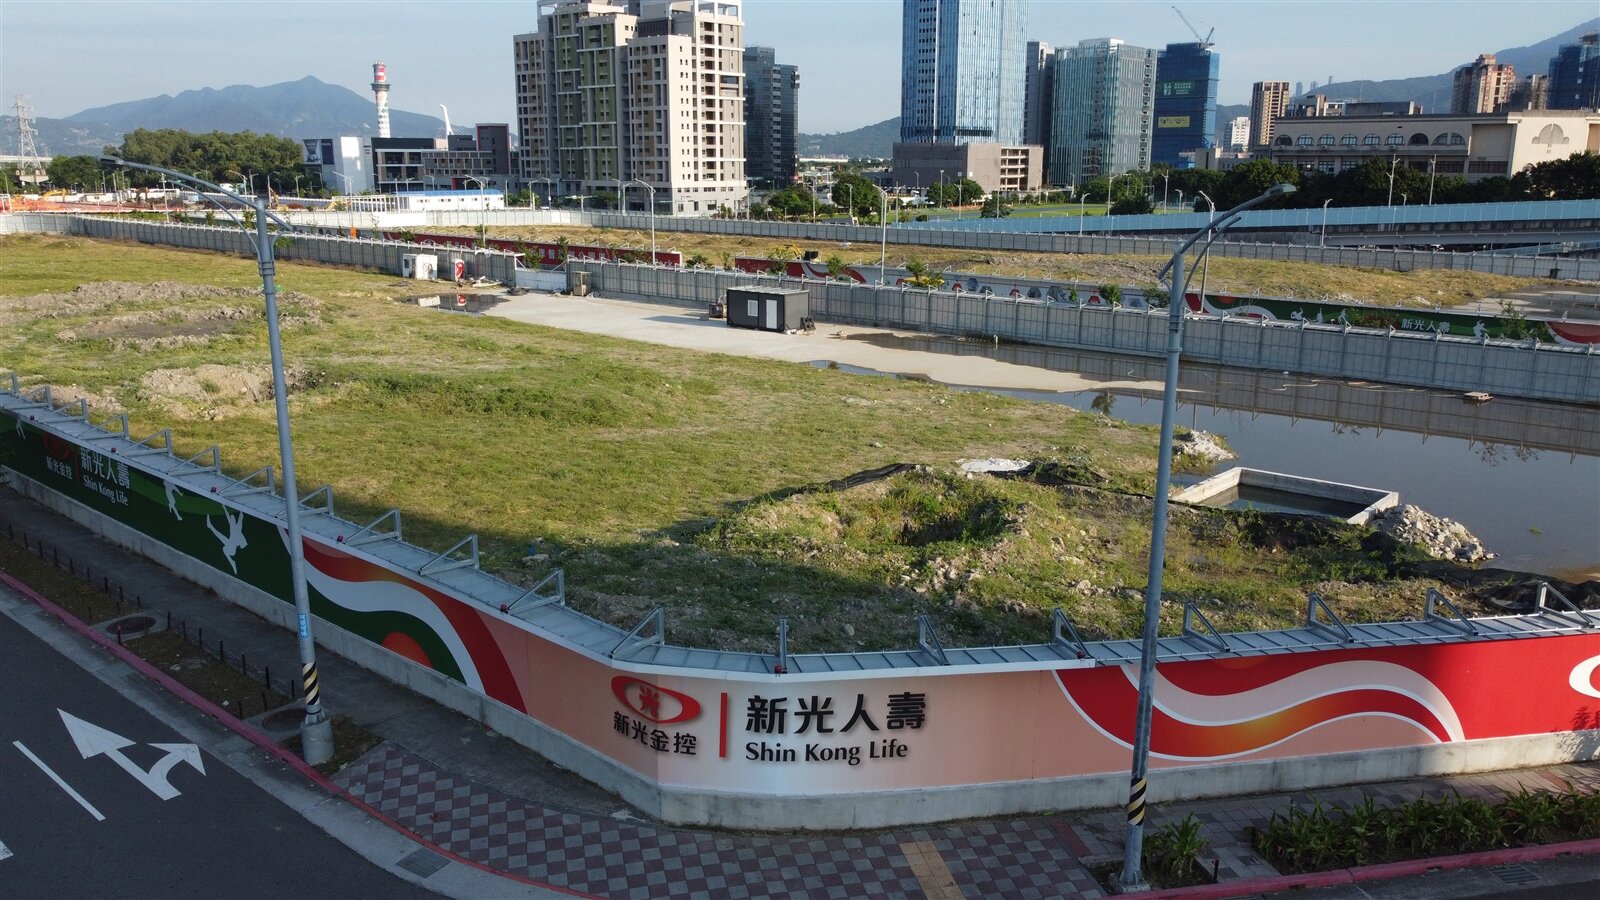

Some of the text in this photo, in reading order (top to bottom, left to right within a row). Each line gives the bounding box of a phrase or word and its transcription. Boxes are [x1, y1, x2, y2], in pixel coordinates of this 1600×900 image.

[80, 447, 130, 489] 新光人壽
[83, 474, 129, 506] Shin Kong Life
[613, 711, 697, 755] 新光金控
[745, 691, 926, 734] 新光人壽
[745, 738, 908, 766] Shin Kong Life
